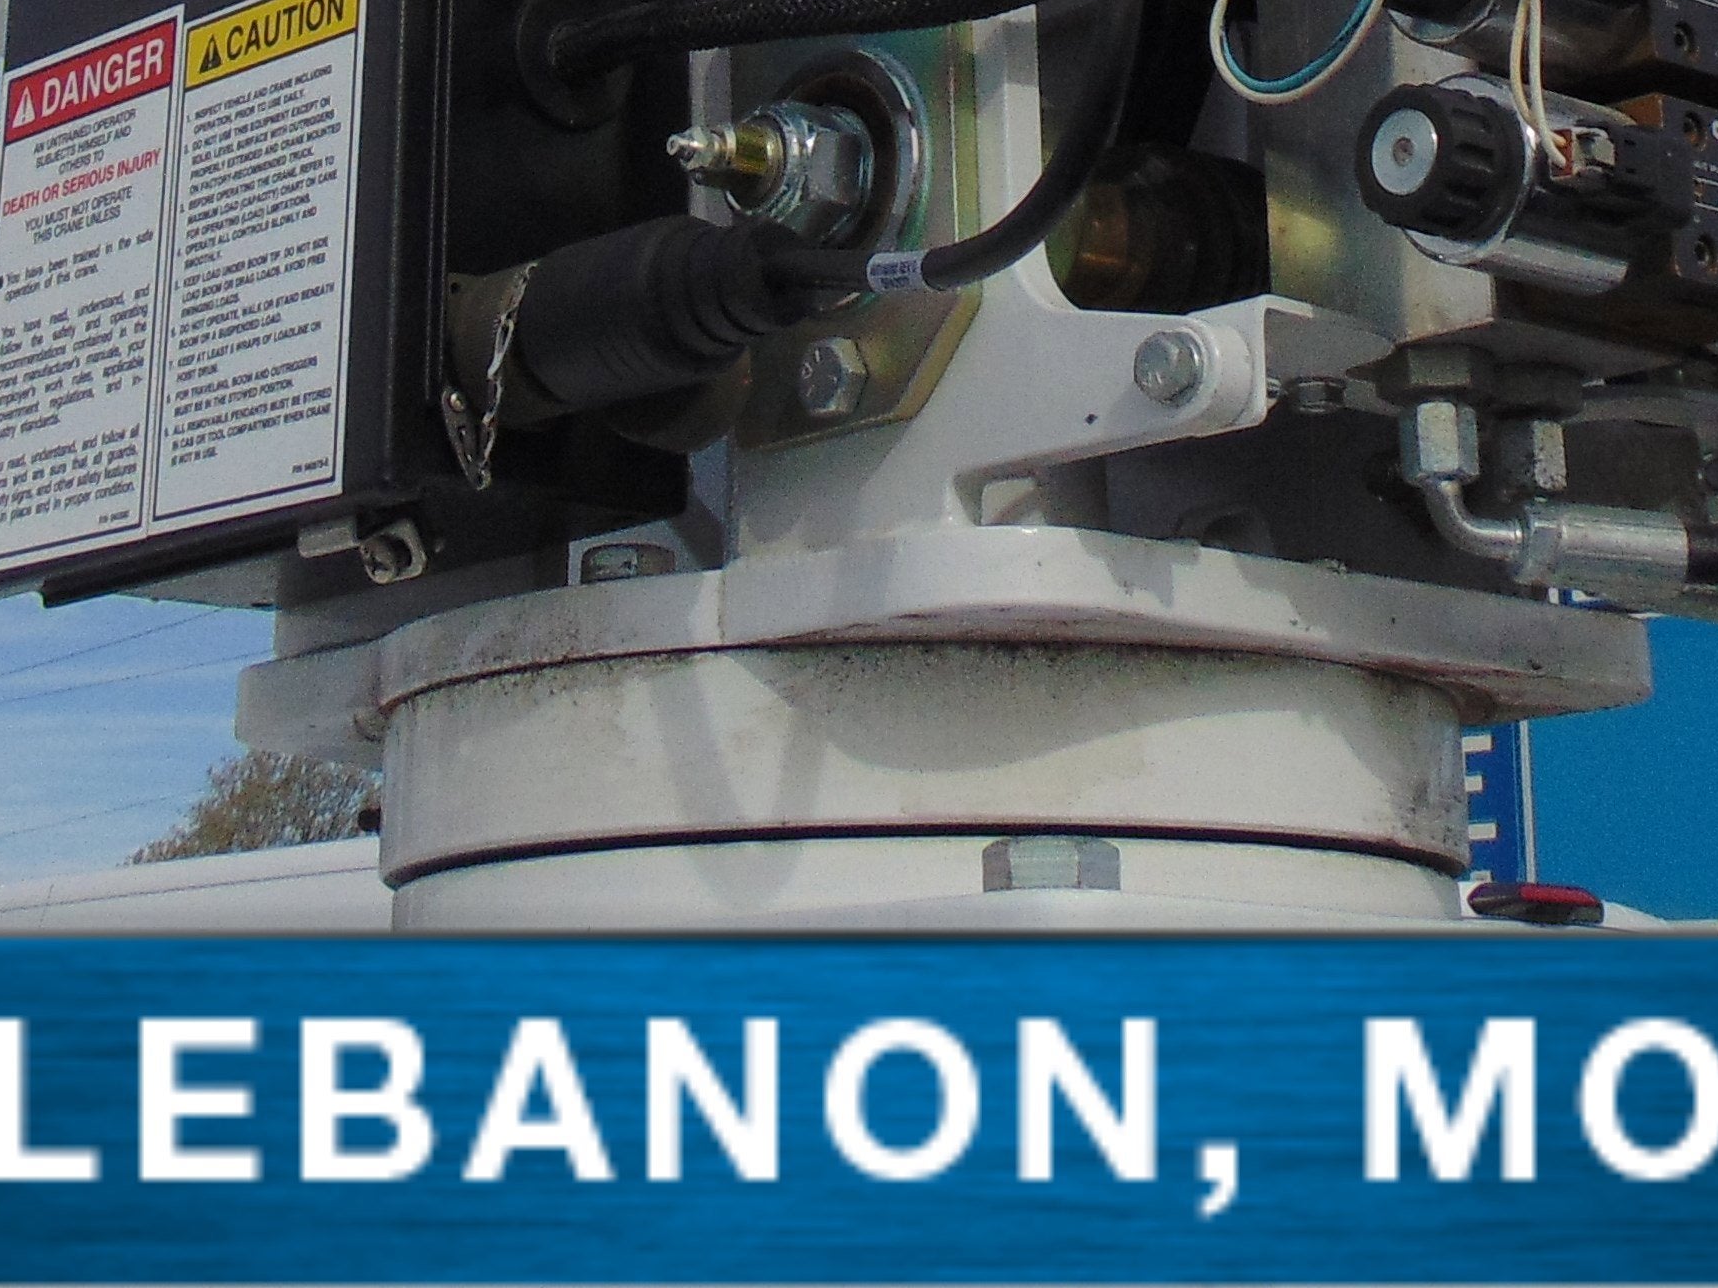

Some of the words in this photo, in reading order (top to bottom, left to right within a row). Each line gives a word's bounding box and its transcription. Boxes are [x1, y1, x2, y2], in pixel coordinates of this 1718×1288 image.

[41, 38, 164, 113] DANGER
[93, 108, 136, 133] OPERATOR
[36, 144, 76, 169] SUBJECTS
[113, 125, 132, 141] AND
[59, 153, 91, 175] OTHERS
[93, 149, 104, 163] TO
[3, 190, 40, 217] DEATH
[42, 183, 60, 203] OR
[62, 164, 114, 197] SERIOUS
[117, 148, 161, 178] INJURY
[25, 215, 44, 232] YOU
[45, 206, 70, 226] MUST
[71, 199, 90, 217] NOT
[91, 186, 133, 210] OPERATE
[33, 227, 52, 244] THIS
[54, 216, 84, 238] CRANE
[86, 204, 121, 227] UNLESS
[118, 238, 131, 250] the
